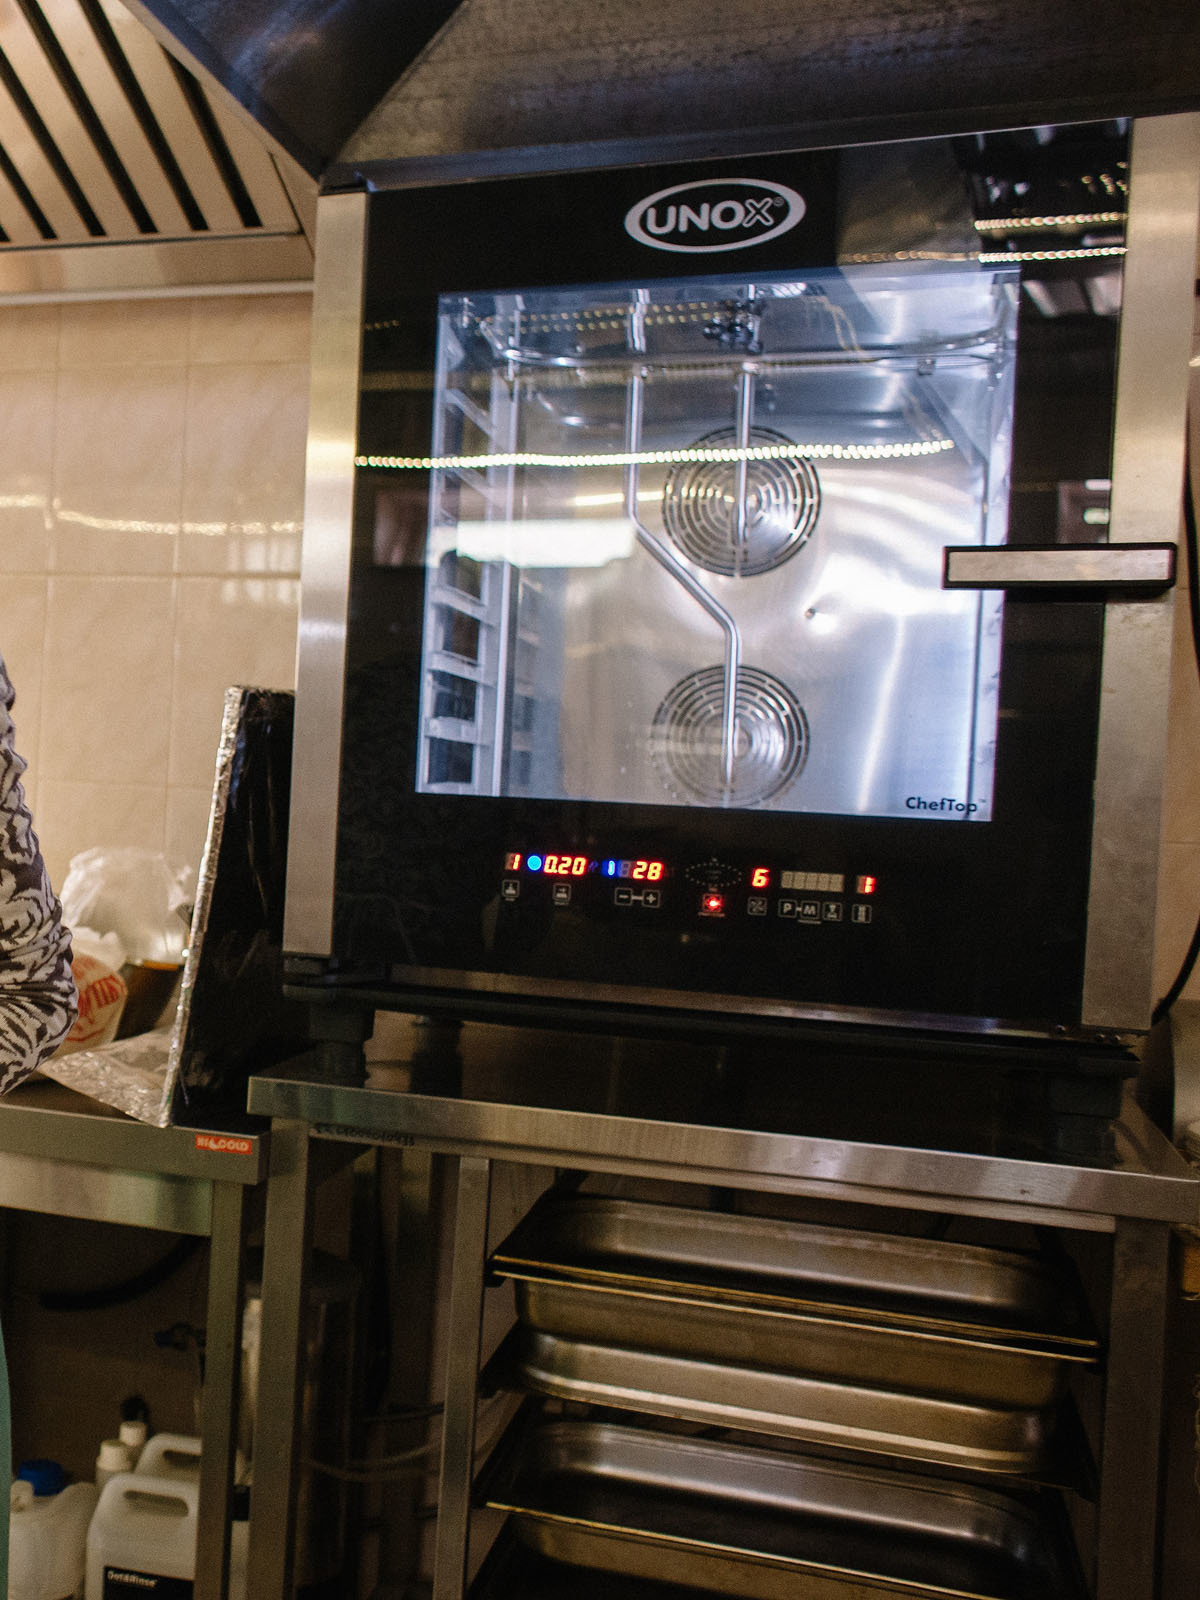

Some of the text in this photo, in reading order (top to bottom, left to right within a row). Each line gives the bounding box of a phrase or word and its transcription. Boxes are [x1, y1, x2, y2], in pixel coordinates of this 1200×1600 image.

[905, 796, 978, 816] ChefTop
[632, 861, 664, 881] 28
[752, 868, 769, 888] 6
